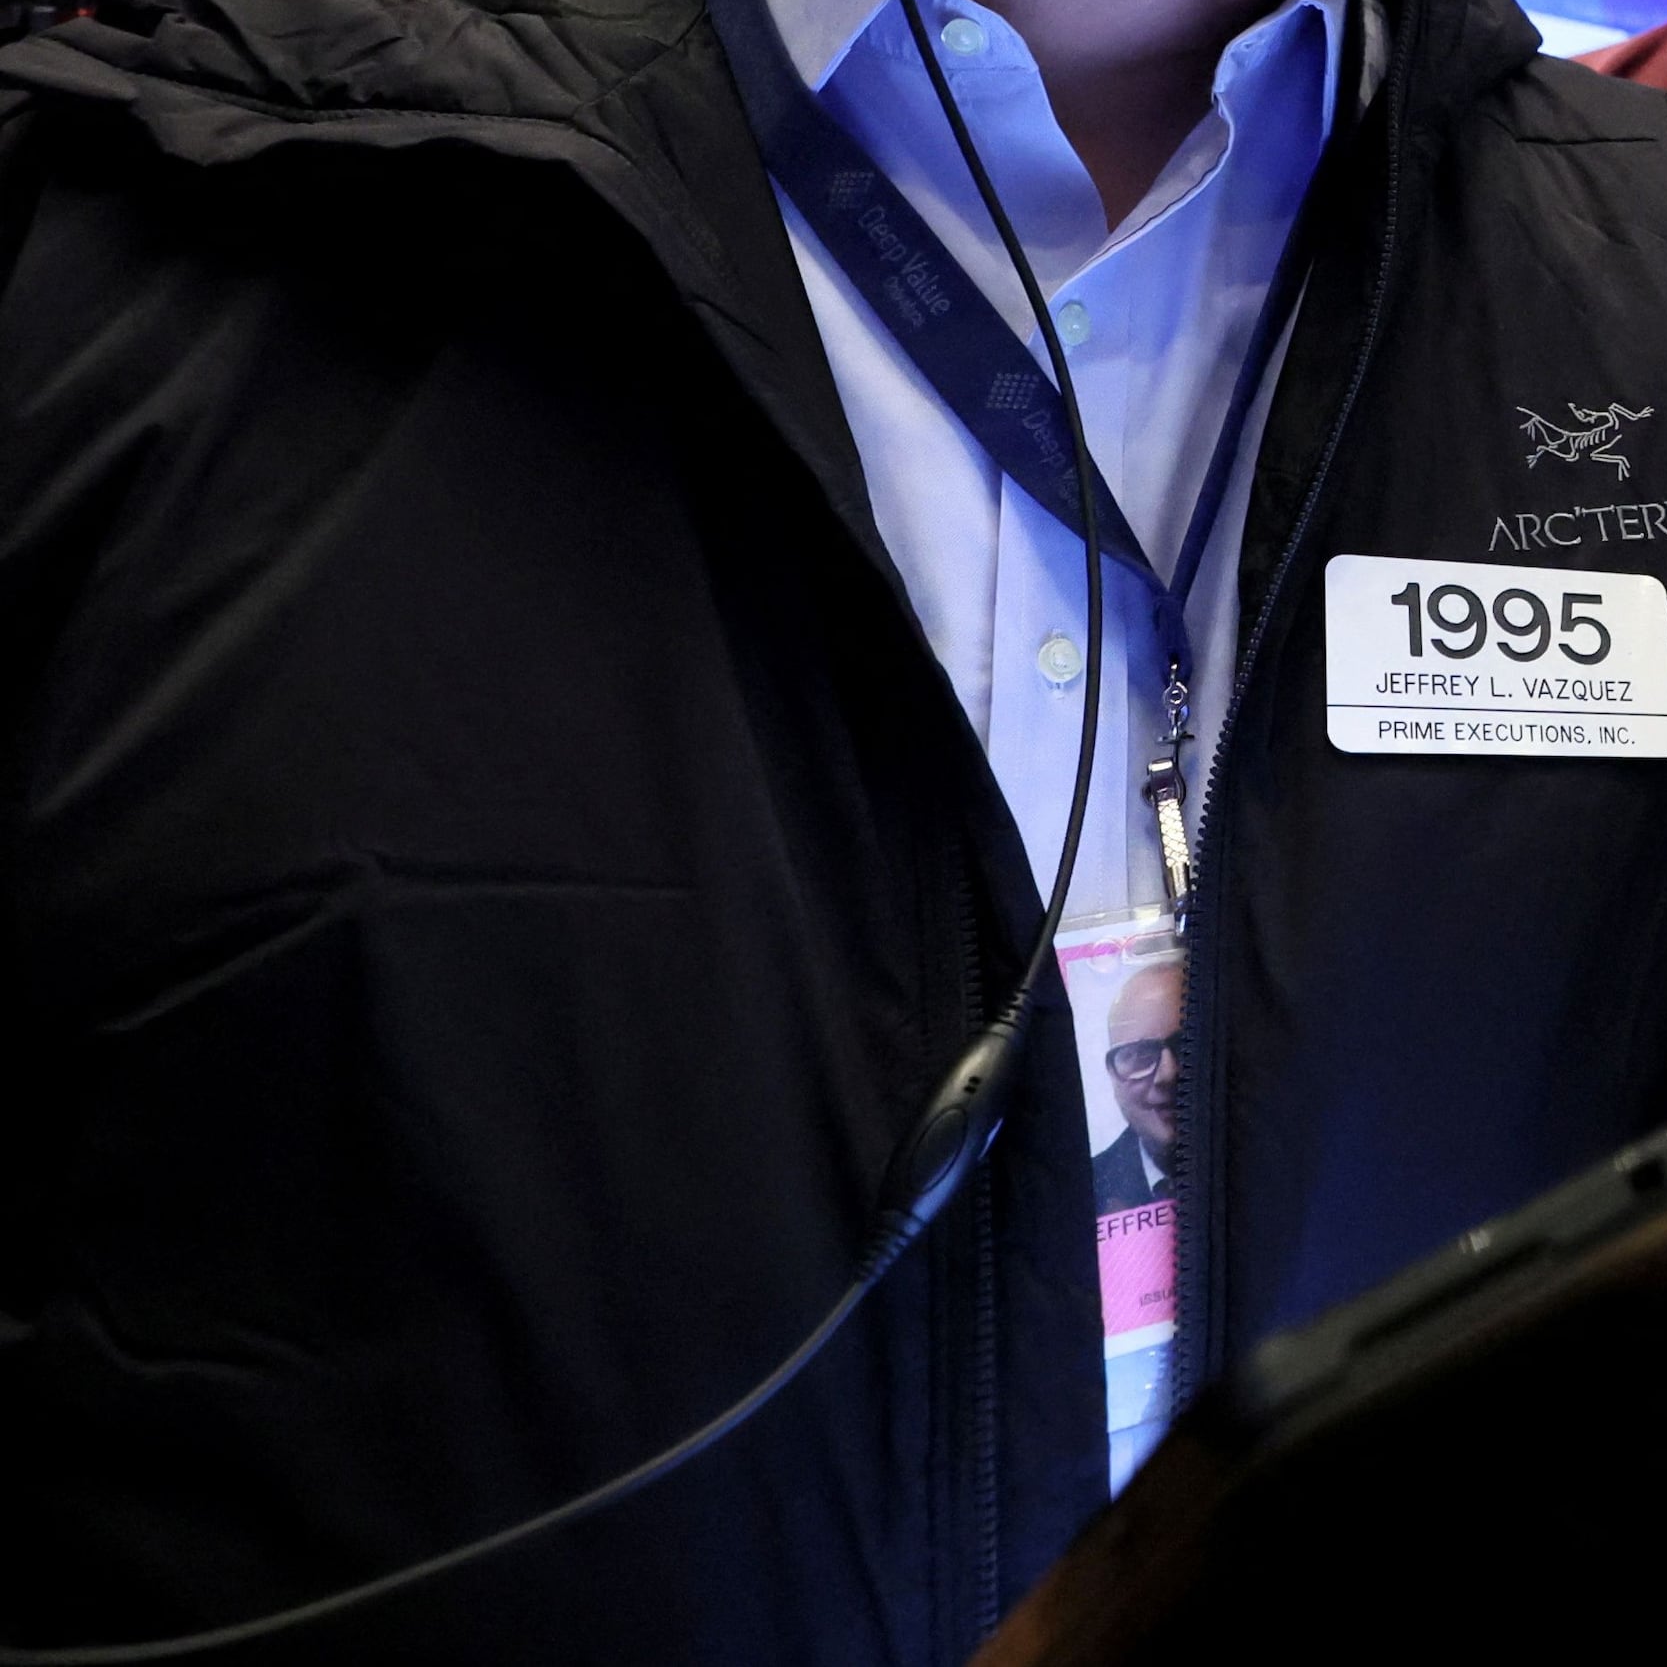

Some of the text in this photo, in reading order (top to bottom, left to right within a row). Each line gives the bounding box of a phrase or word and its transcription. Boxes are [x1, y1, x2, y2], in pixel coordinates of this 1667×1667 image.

[858, 205, 906, 261] Deep
[900, 252, 950, 317] Value
[1391, 582, 1612, 665] 1995
[1376, 672, 1633, 702] JEFFREY L. VAZQUEZ
[1378, 721, 1446, 741] PRIME
[1599, 727, 1636, 745] INC.
